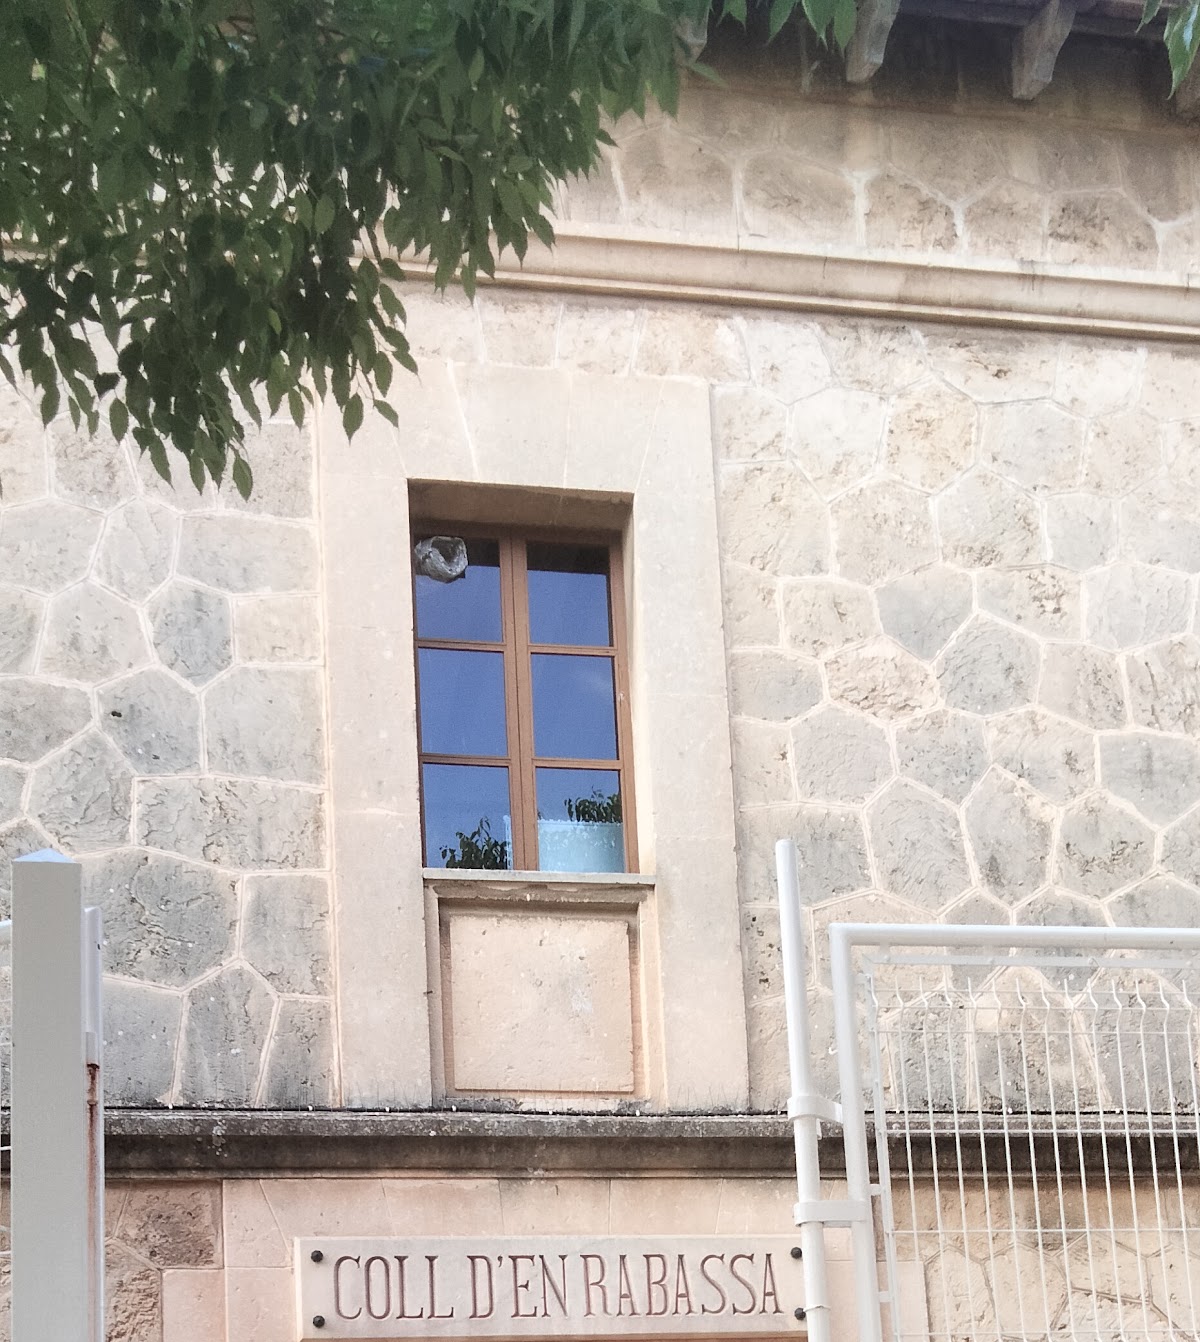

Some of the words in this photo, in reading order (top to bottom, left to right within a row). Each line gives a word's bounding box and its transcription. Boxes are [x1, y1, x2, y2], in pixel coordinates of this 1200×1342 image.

[334, 1255, 455, 1320] COLL
[468, 1254, 569, 1318] D'EN
[581, 1252, 784, 1316] RABASSA
